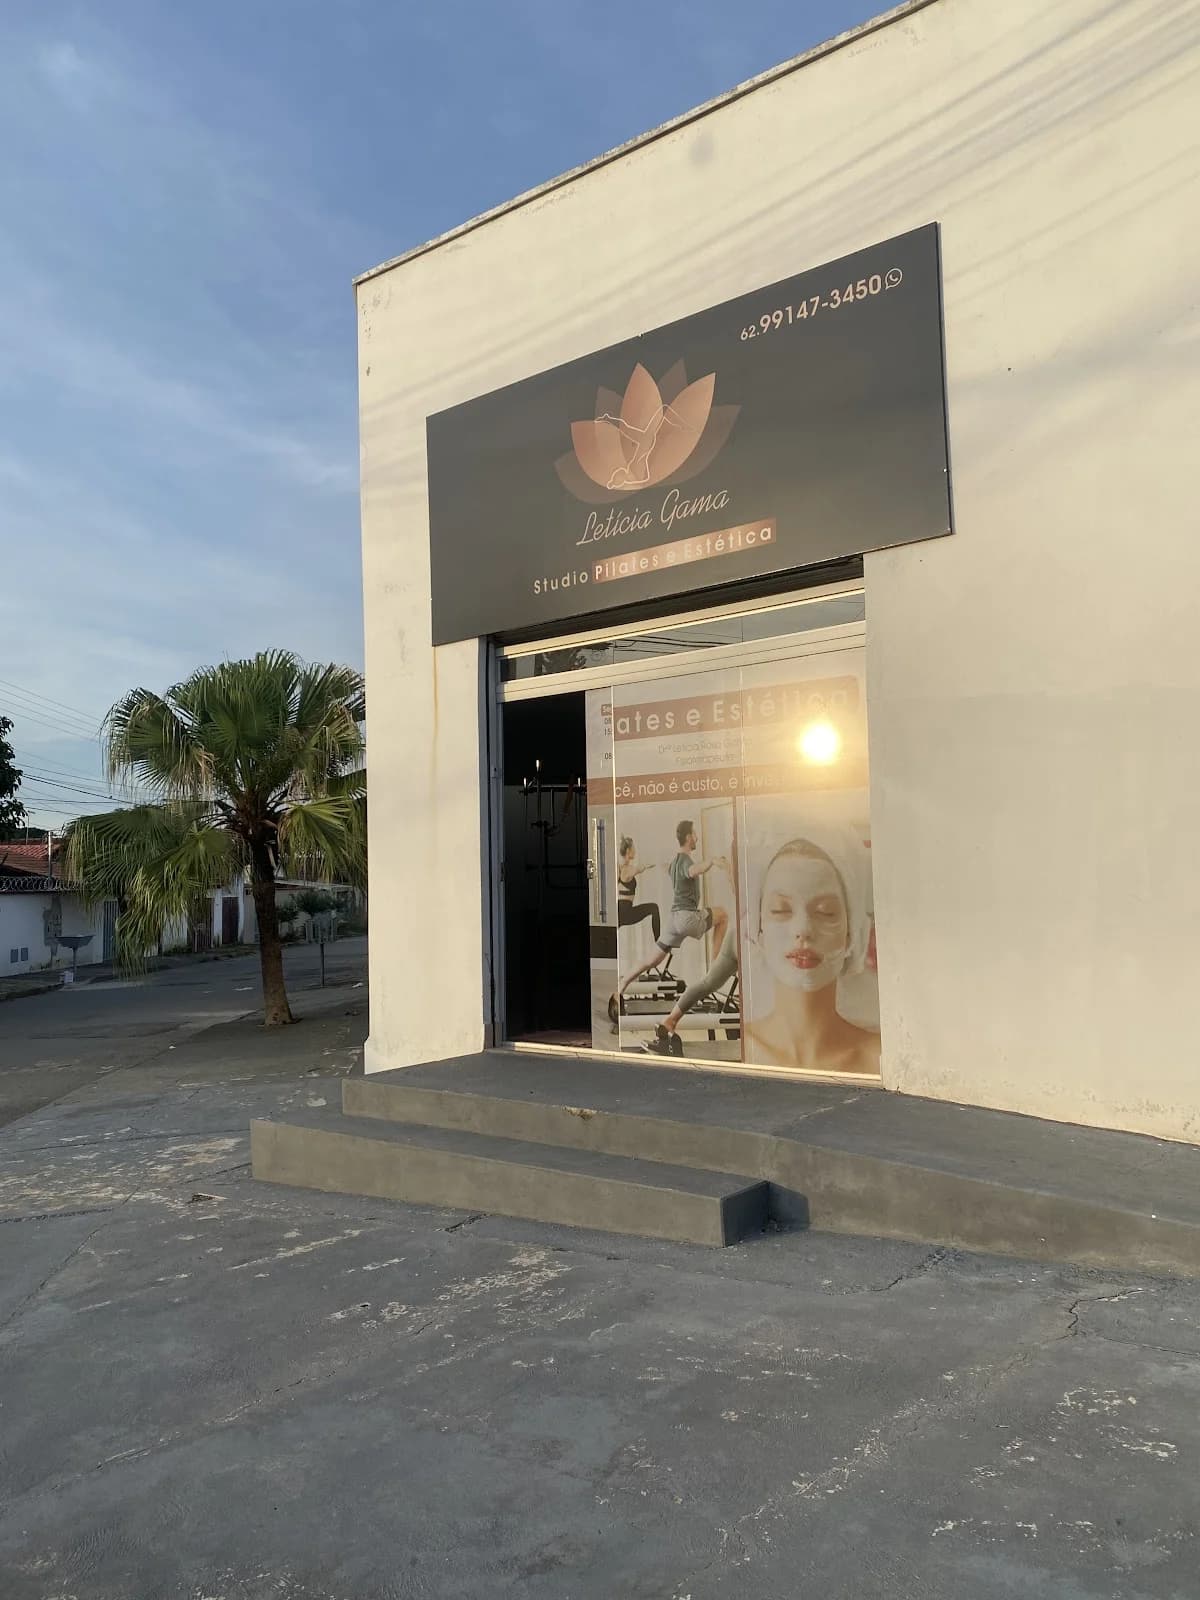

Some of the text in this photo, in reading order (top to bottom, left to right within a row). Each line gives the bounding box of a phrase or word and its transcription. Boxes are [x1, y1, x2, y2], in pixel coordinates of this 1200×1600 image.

[575, 488, 730, 546] Letícia Gama
[533, 527, 772, 594] Studio Pilates e Estética
[686, 707, 701, 727] e
[638, 780, 665, 796] não
[668, 777, 679, 793] é
